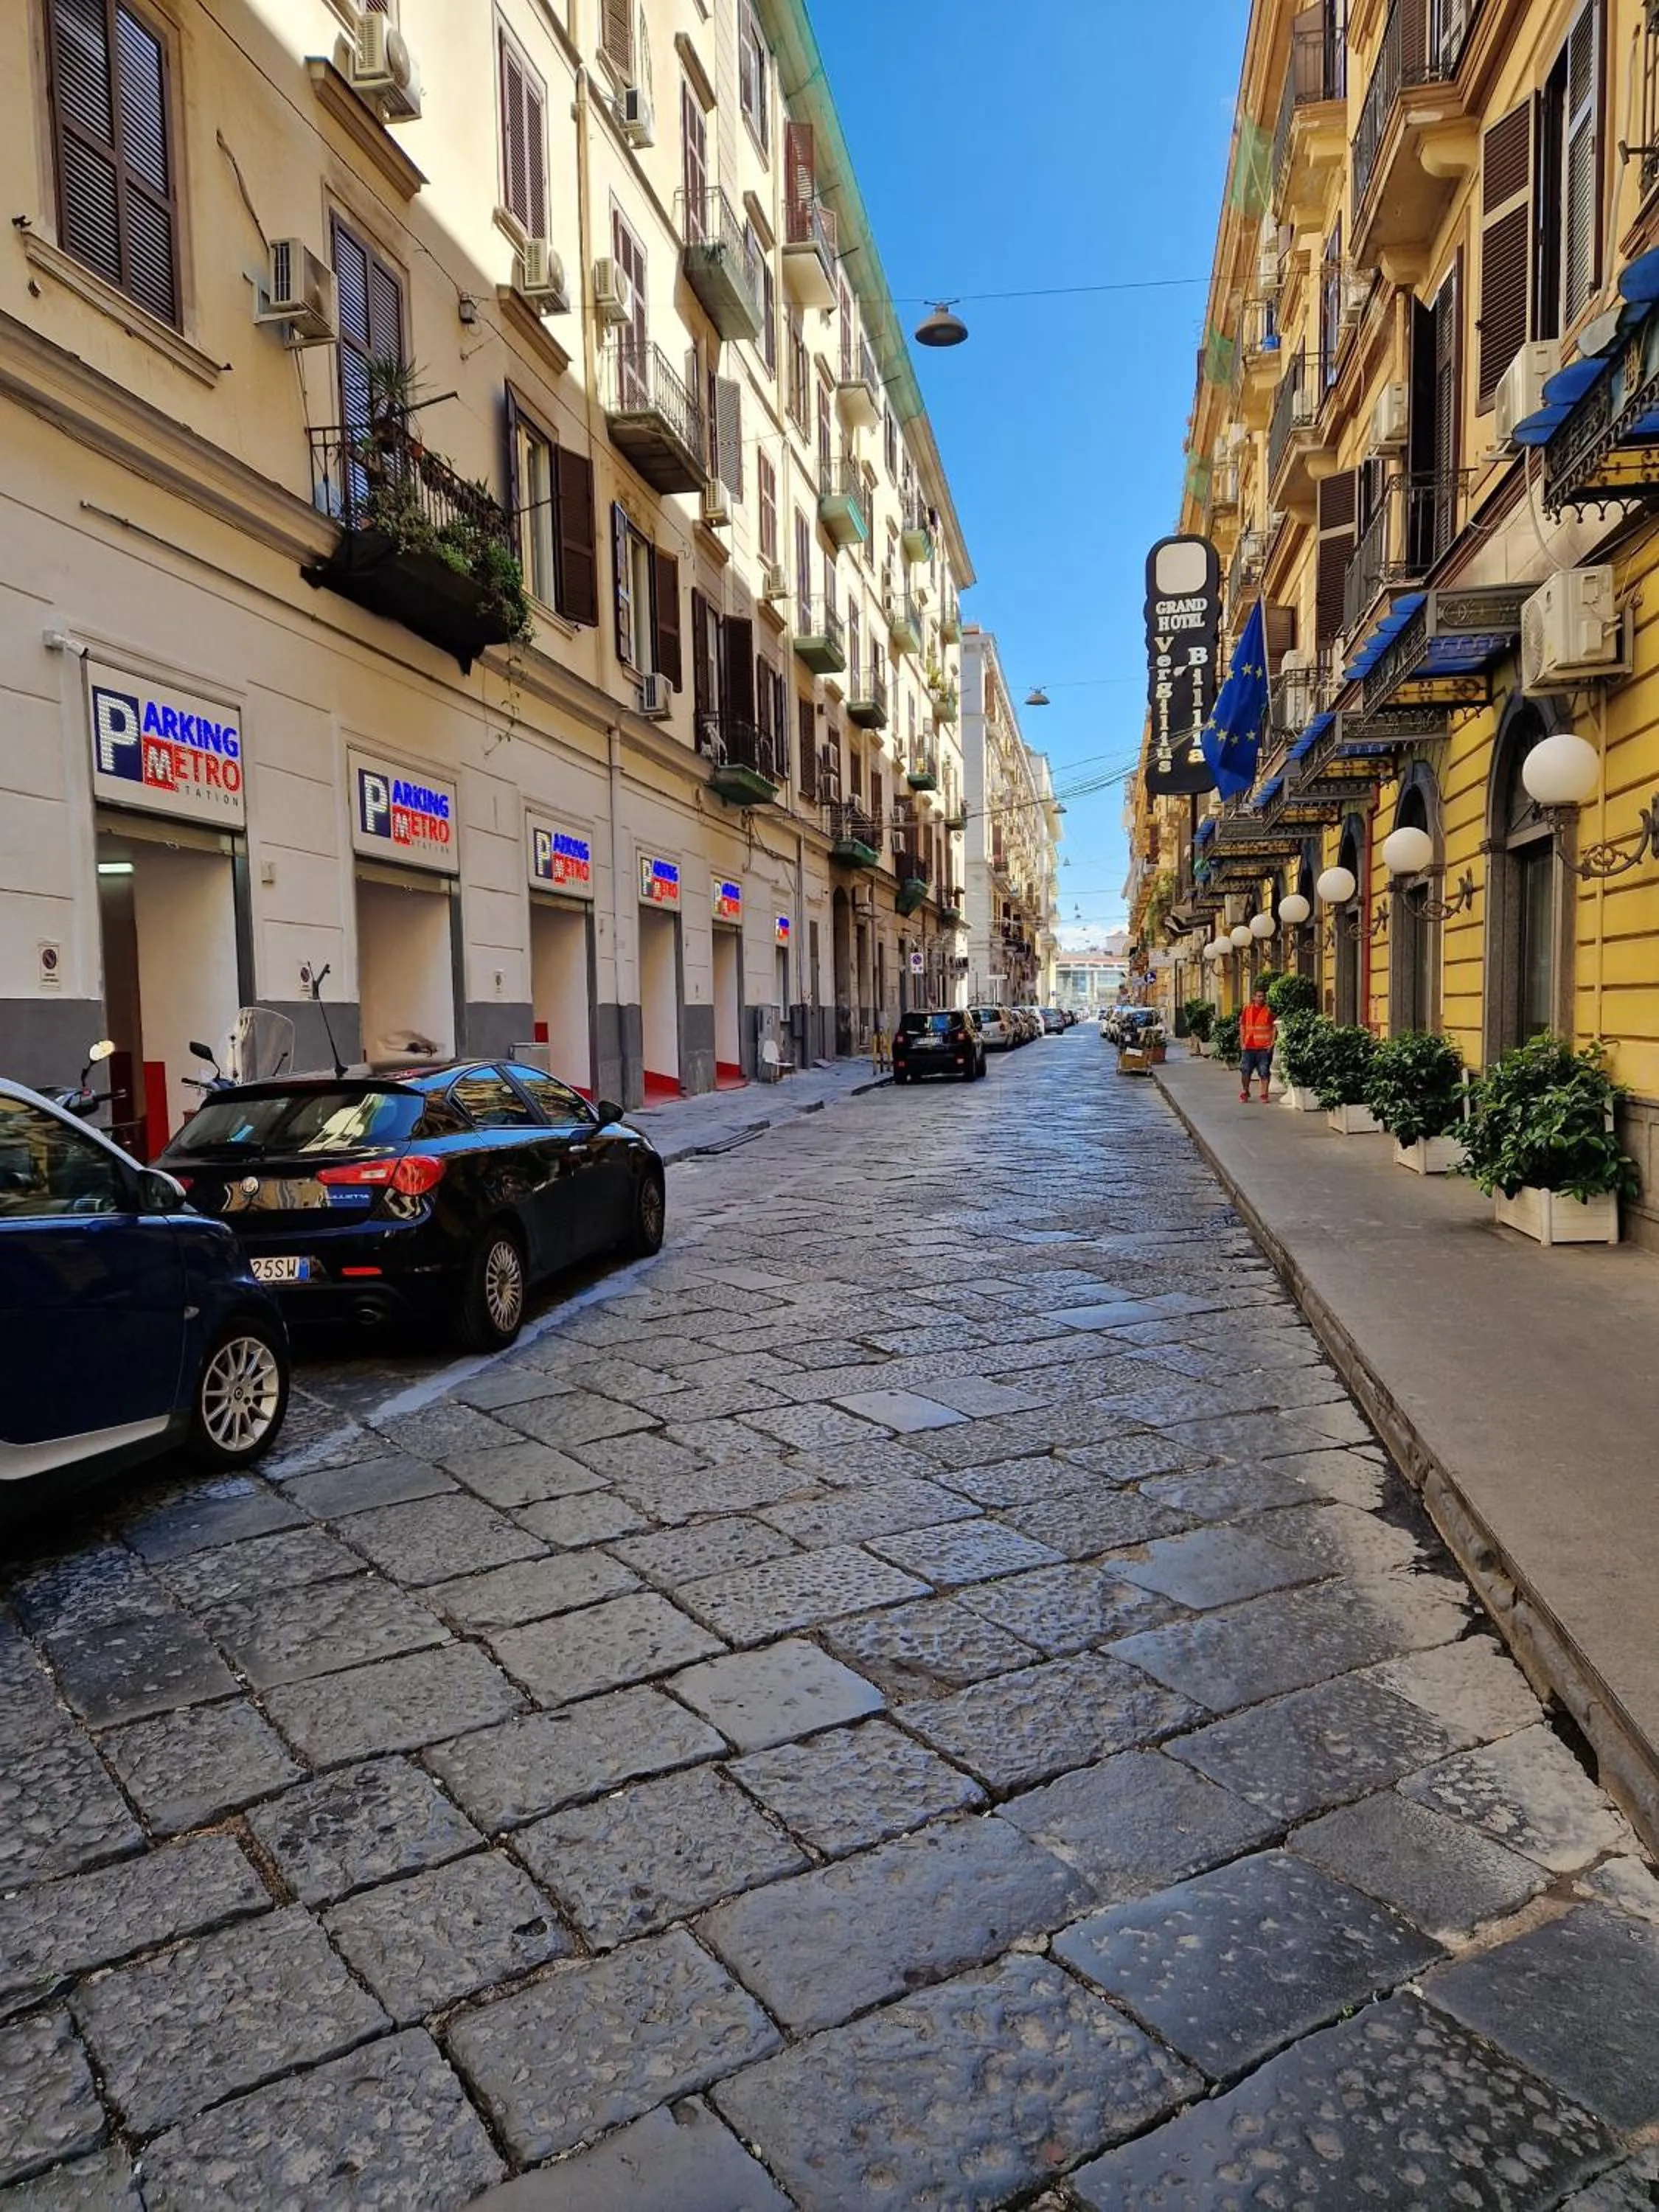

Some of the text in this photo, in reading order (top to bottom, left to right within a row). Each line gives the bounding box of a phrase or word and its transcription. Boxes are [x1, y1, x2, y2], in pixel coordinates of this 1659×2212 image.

[1155, 597, 1208, 615] GRAND
[1158, 611, 1206, 632] HOTEL
[1154, 636, 1175, 773] Vergilius
[1188, 647, 1208, 763] Billia
[147, 743, 240, 793] METRO
[393, 810, 450, 844] METRO
